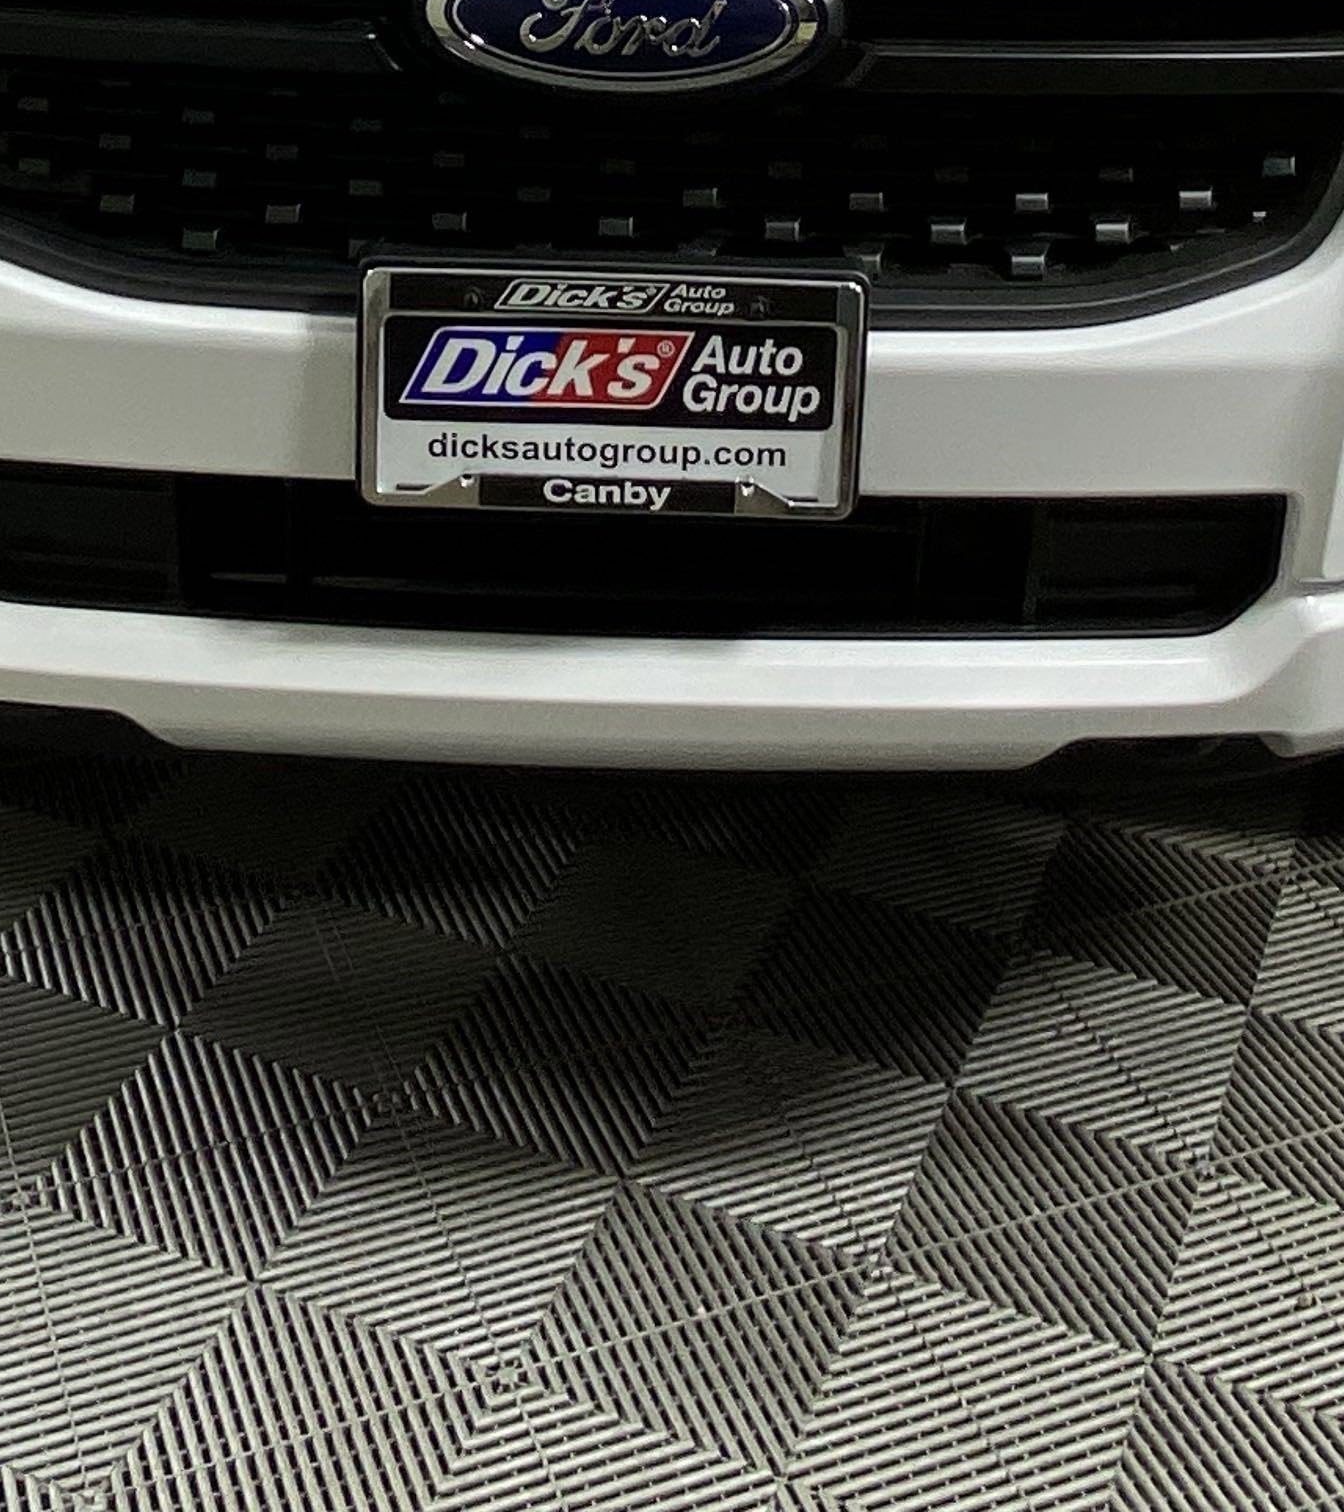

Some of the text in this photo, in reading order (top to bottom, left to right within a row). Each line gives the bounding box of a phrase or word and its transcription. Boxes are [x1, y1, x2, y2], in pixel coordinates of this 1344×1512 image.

[506, 282, 726, 310] Dick's Auto
[663, 297, 735, 316] Group
[421, 335, 804, 399] Dick's Auto
[682, 374, 821, 422] Group
[428, 433, 787, 471] dicksautogroup.com
[542, 478, 672, 511] Canby
